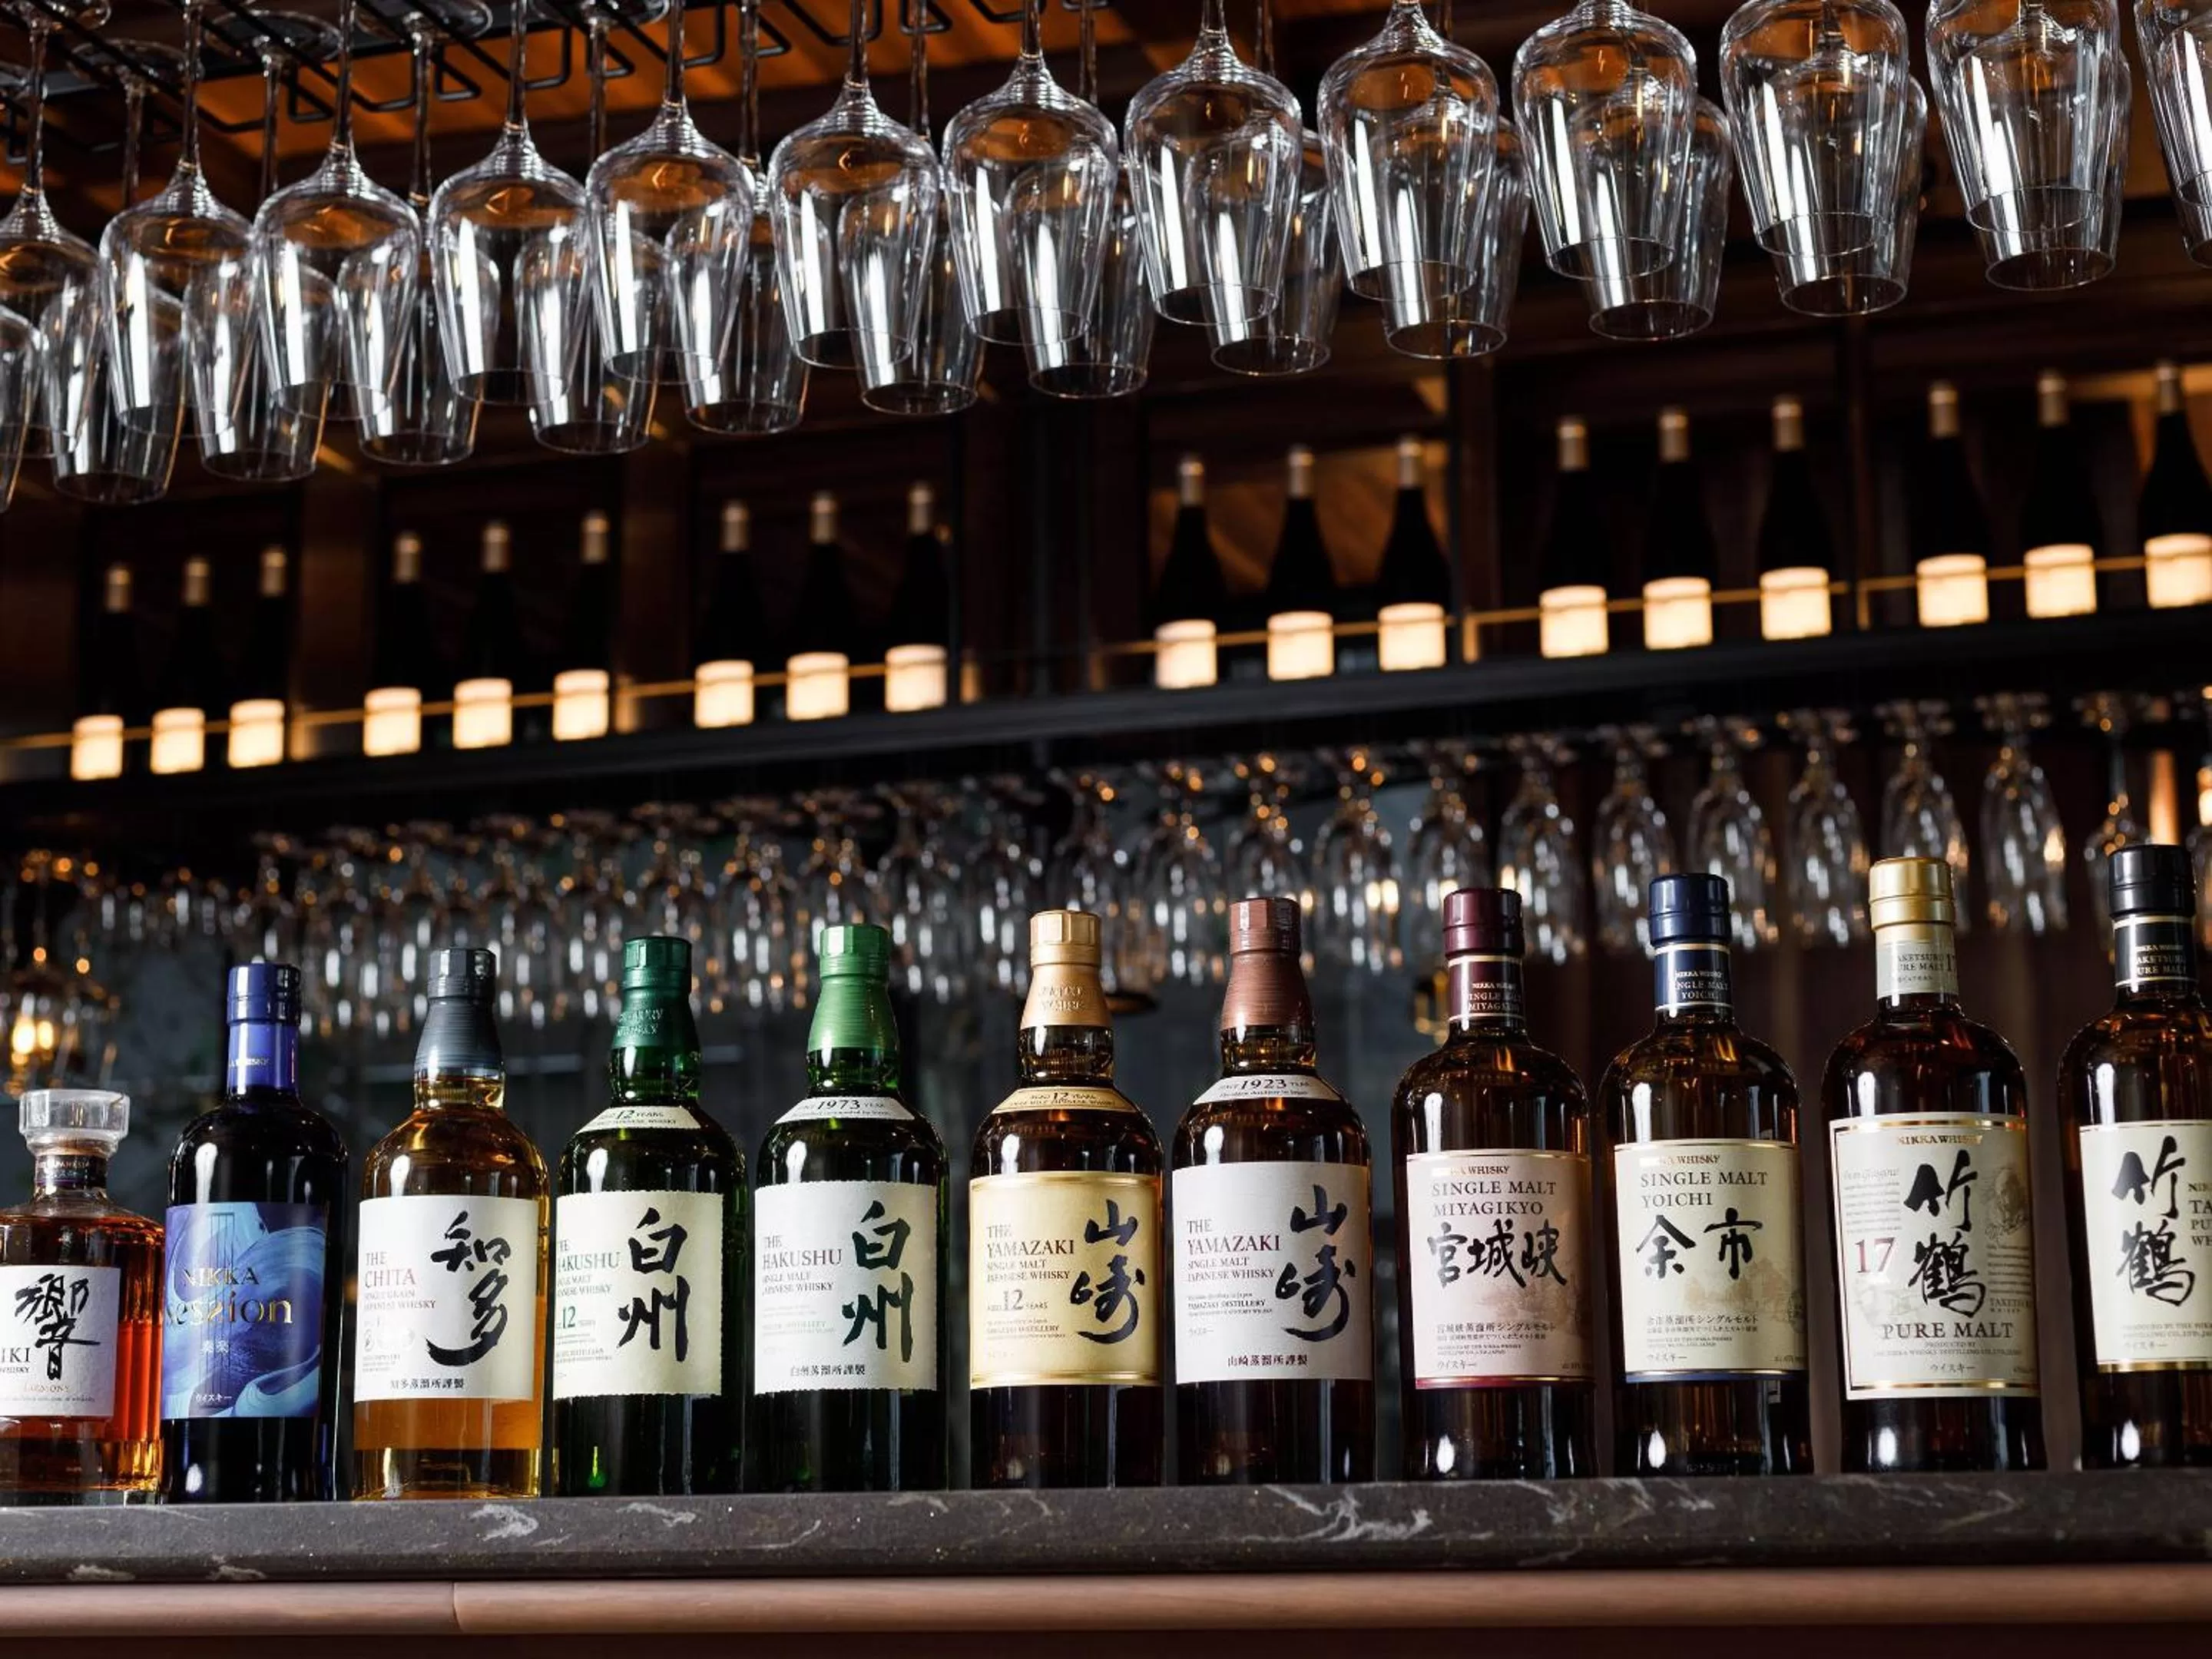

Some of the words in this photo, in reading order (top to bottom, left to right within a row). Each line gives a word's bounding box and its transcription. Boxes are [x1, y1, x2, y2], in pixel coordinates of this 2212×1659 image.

[1241, 1078, 1287, 1090] 1923
[818, 1099, 861, 1110] 1973
[1677, 1154, 1721, 1164] WHISKY
[1468, 1166, 1511, 1175] WHISKY
[1641, 1171, 1712, 1188] SINGLE
[1718, 1171, 1769, 1185] MALT
[1432, 1181, 1502, 1197] SINGLE
[1508, 1181, 1558, 1195] MALT
[1433, 1201, 1544, 1217] MIYAGIKYO
[1641, 1192, 1714, 1209] YOICHI
[1187, 1219, 1213, 1234] THE
[2111, 1134, 2196, 1306] 竹鶴
[986, 1224, 1012, 1239] THE
[1903, 1149, 1986, 1319] 竹鶴
[763, 1235, 783, 1249] THE
[987, 1239, 1075, 1259] YAMAZAKI
[1187, 1234, 1280, 1255] YAMAZAKI
[1636, 1207, 1763, 1280] 余市
[365, 1252, 389, 1267] THE
[763, 1249, 843, 1270] HAKUSHU
[1019, 1259, 1046, 1269] MALT
[1187, 1259, 1218, 1270] SINGLE
[1220, 1257, 1250, 1267] MALT
[1854, 1237, 1896, 1275] 17
[182, 1267, 260, 1286] NIKKA
[364, 1268, 416, 1289] CHITA
[841, 1200, 914, 1363] 白州
[1030, 1270, 1071, 1280] WHISKY
[1187, 1270, 1230, 1283] JAPANESE
[1232, 1269, 1276, 1280] WHISKY
[425, 1210, 512, 1367] 知多
[615, 1207, 690, 1363] 白州
[796, 1281, 834, 1292] WHISKY
[1002, 1288, 1024, 1311] 12
[562, 1305, 576, 1330] 12
[14, 1273, 101, 1381] 響
[1882, 1322, 1945, 1339] PURE
[1954, 1322, 2014, 1339] MALT
